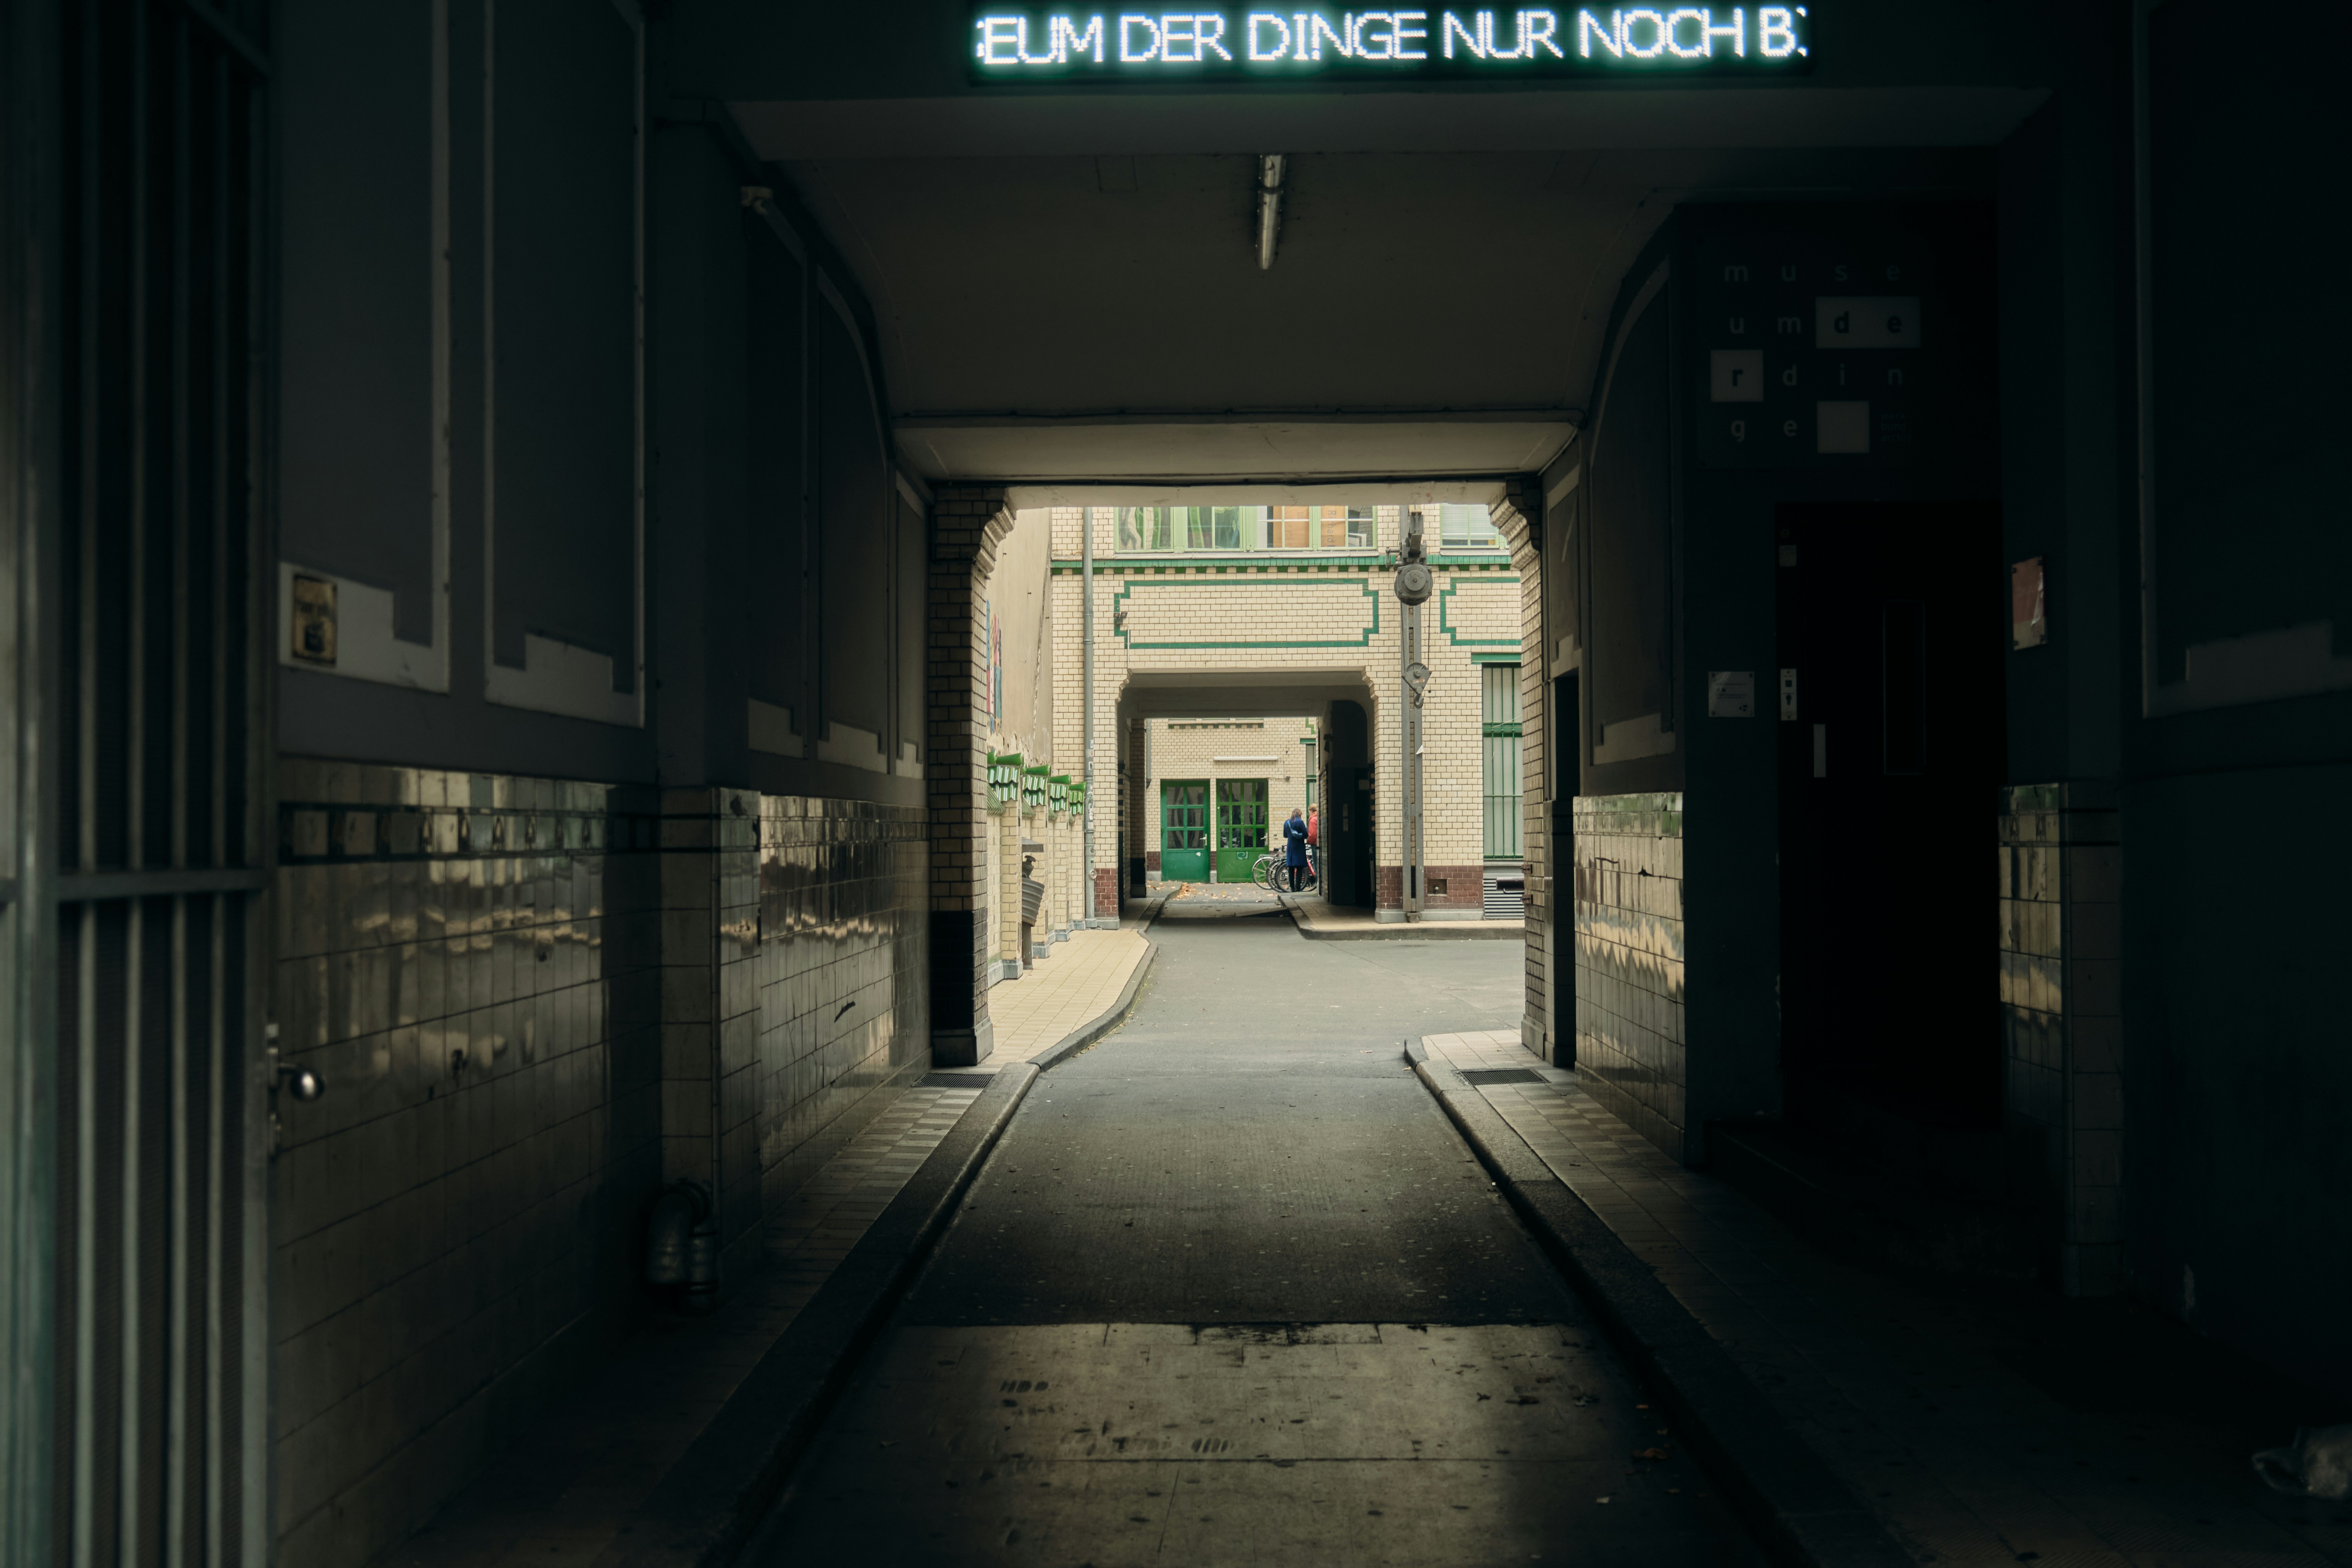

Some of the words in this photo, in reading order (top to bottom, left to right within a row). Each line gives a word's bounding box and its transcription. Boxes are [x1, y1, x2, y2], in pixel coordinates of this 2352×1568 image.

[976, 15, 1103, 64] EUM
[1120, 14, 1232, 61] DER
[1248, 12, 1426, 61] DINGE
[1443, 11, 1563, 59] NUR
[1579, 8, 1744, 58] NOCH
[1759, 6, 1808, 57] B
[1880, 422, 1906, 430] bund
